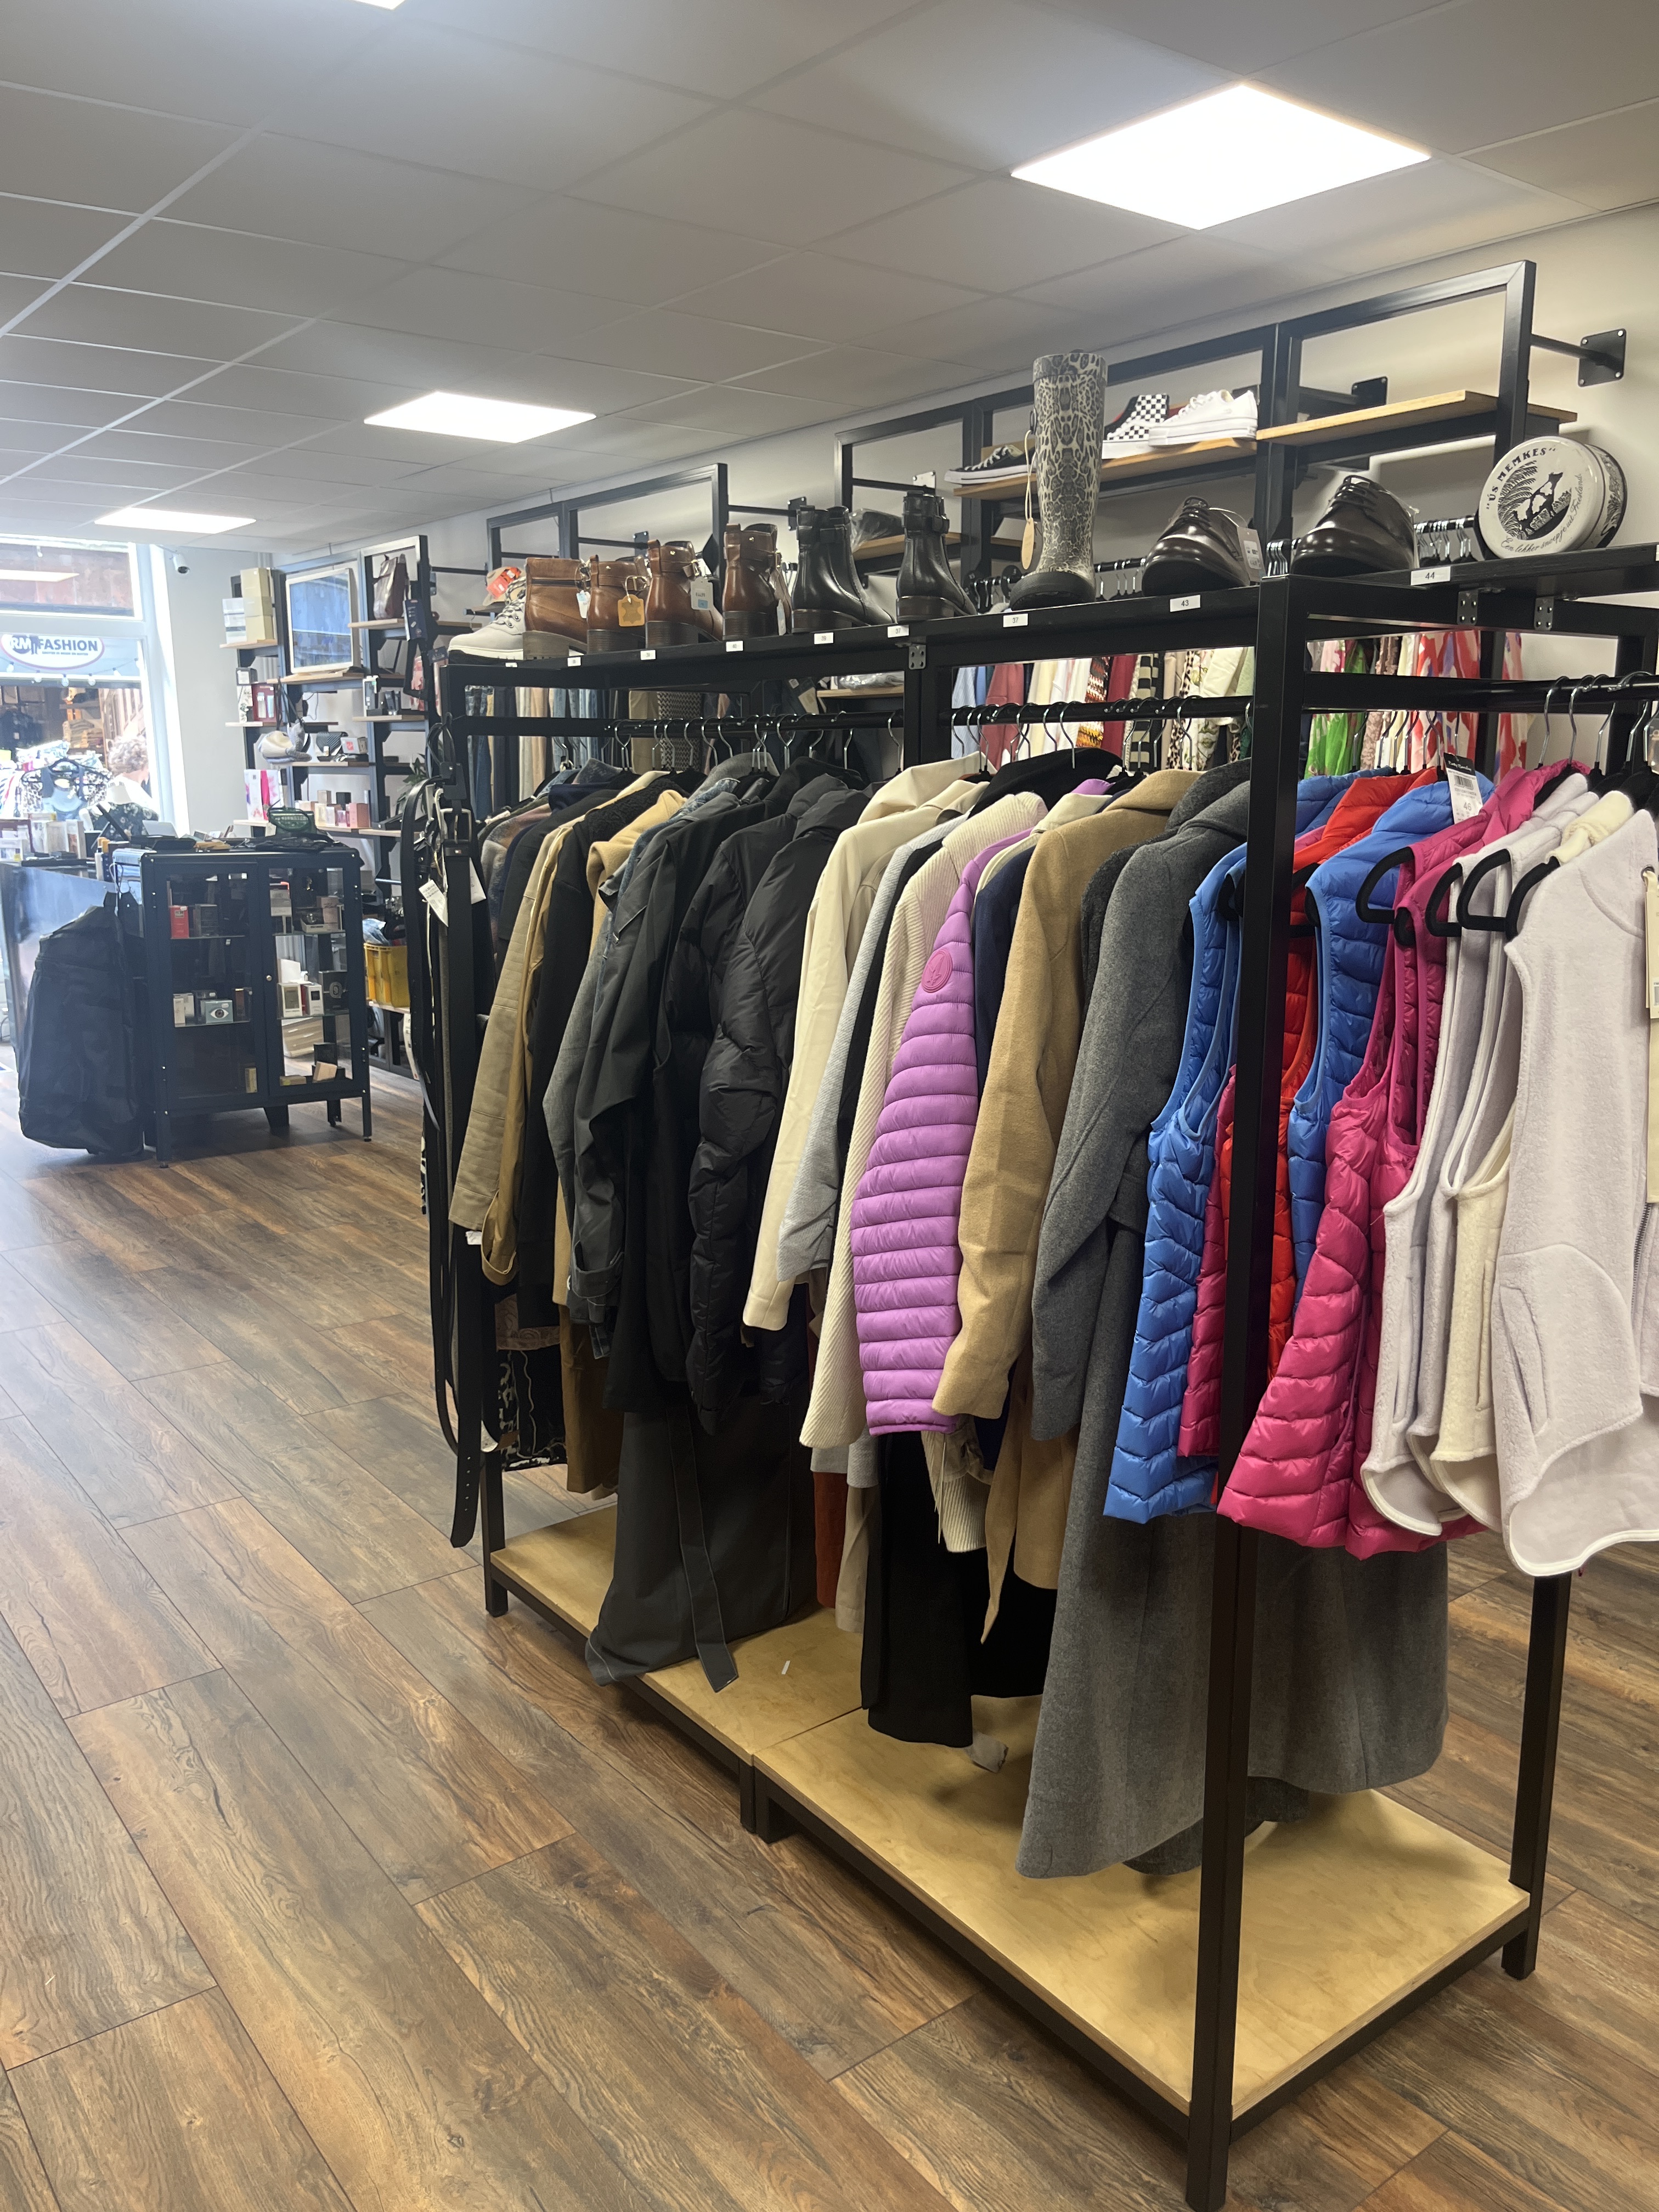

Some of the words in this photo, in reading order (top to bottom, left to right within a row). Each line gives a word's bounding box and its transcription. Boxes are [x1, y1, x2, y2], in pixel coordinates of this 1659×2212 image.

[1500, 535, 1514, 551] Een
[1515, 543, 1540, 553] lekker
[1540, 526, 1567, 549] snoepje
[1566, 515, 1575, 528] uit
[38, 638, 98, 652] FASHION
[1463, 802, 1472, 811] 46
